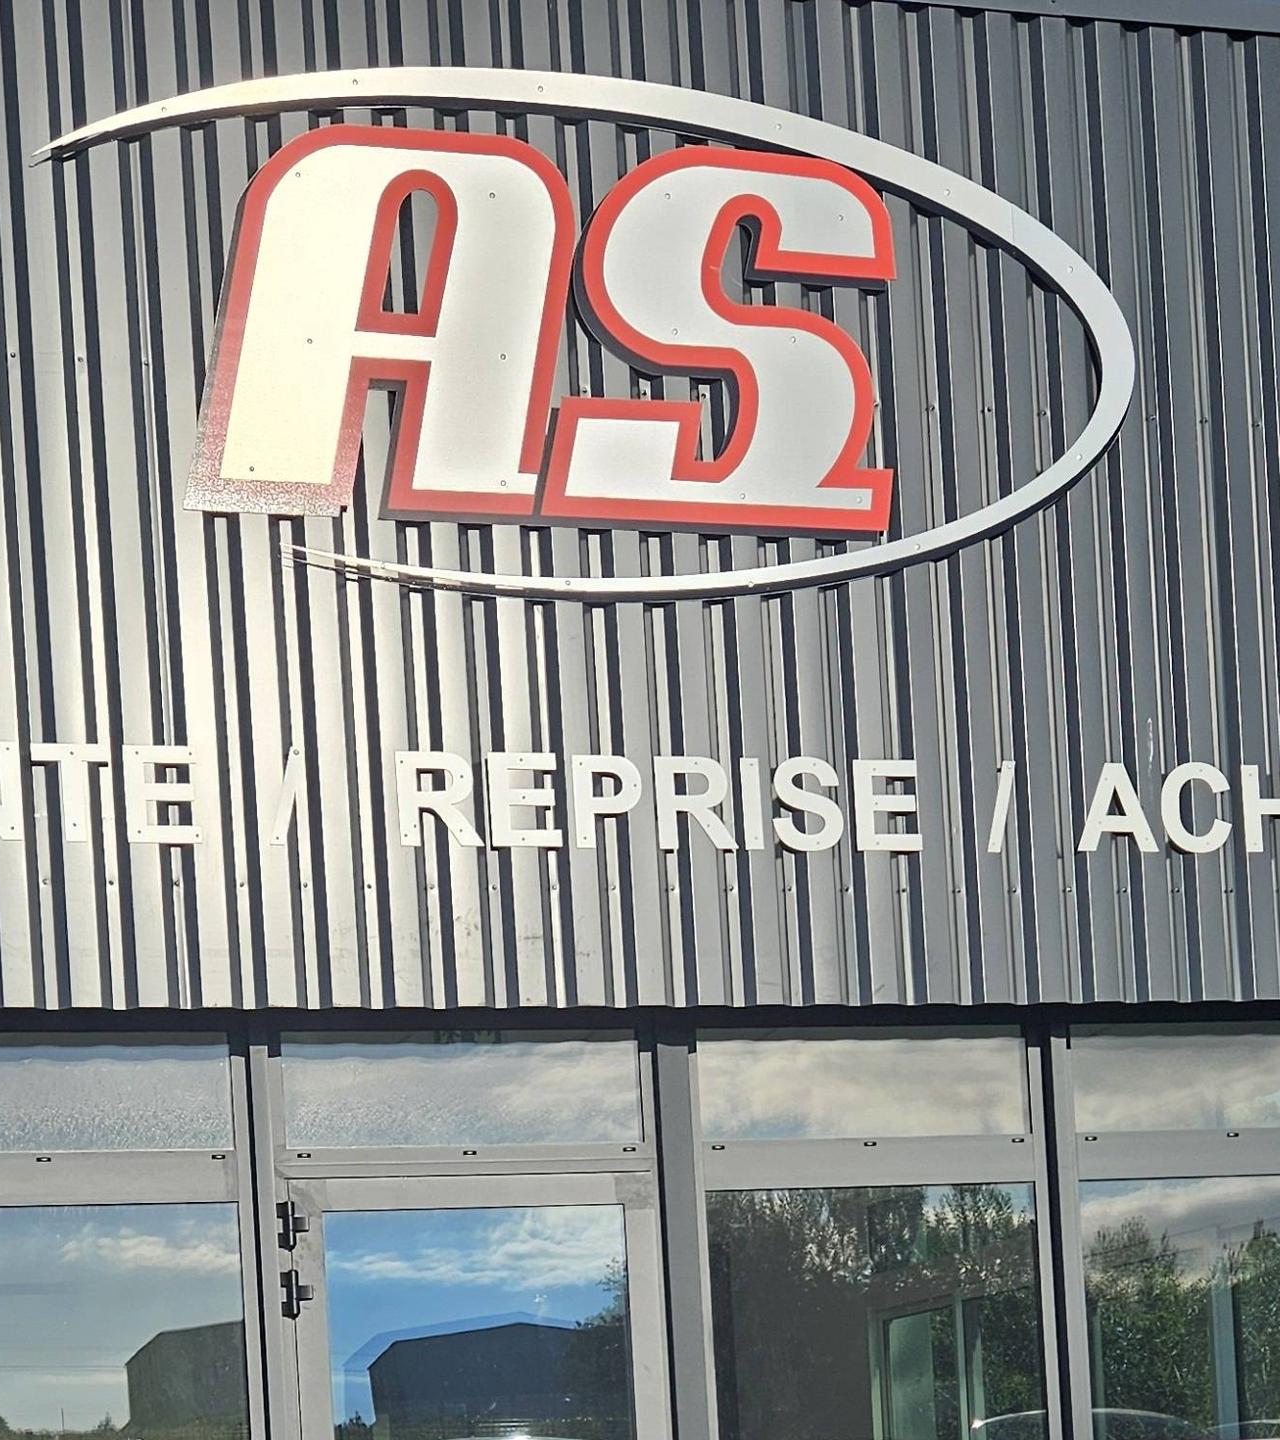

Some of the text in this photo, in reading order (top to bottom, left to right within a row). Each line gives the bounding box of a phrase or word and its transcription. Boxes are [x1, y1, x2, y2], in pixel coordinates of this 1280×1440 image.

[184, 124, 897, 535] AS
[270, 745, 305, 846] /
[395, 750, 923, 853] REPRISE
[987, 760, 1016, 854] /
